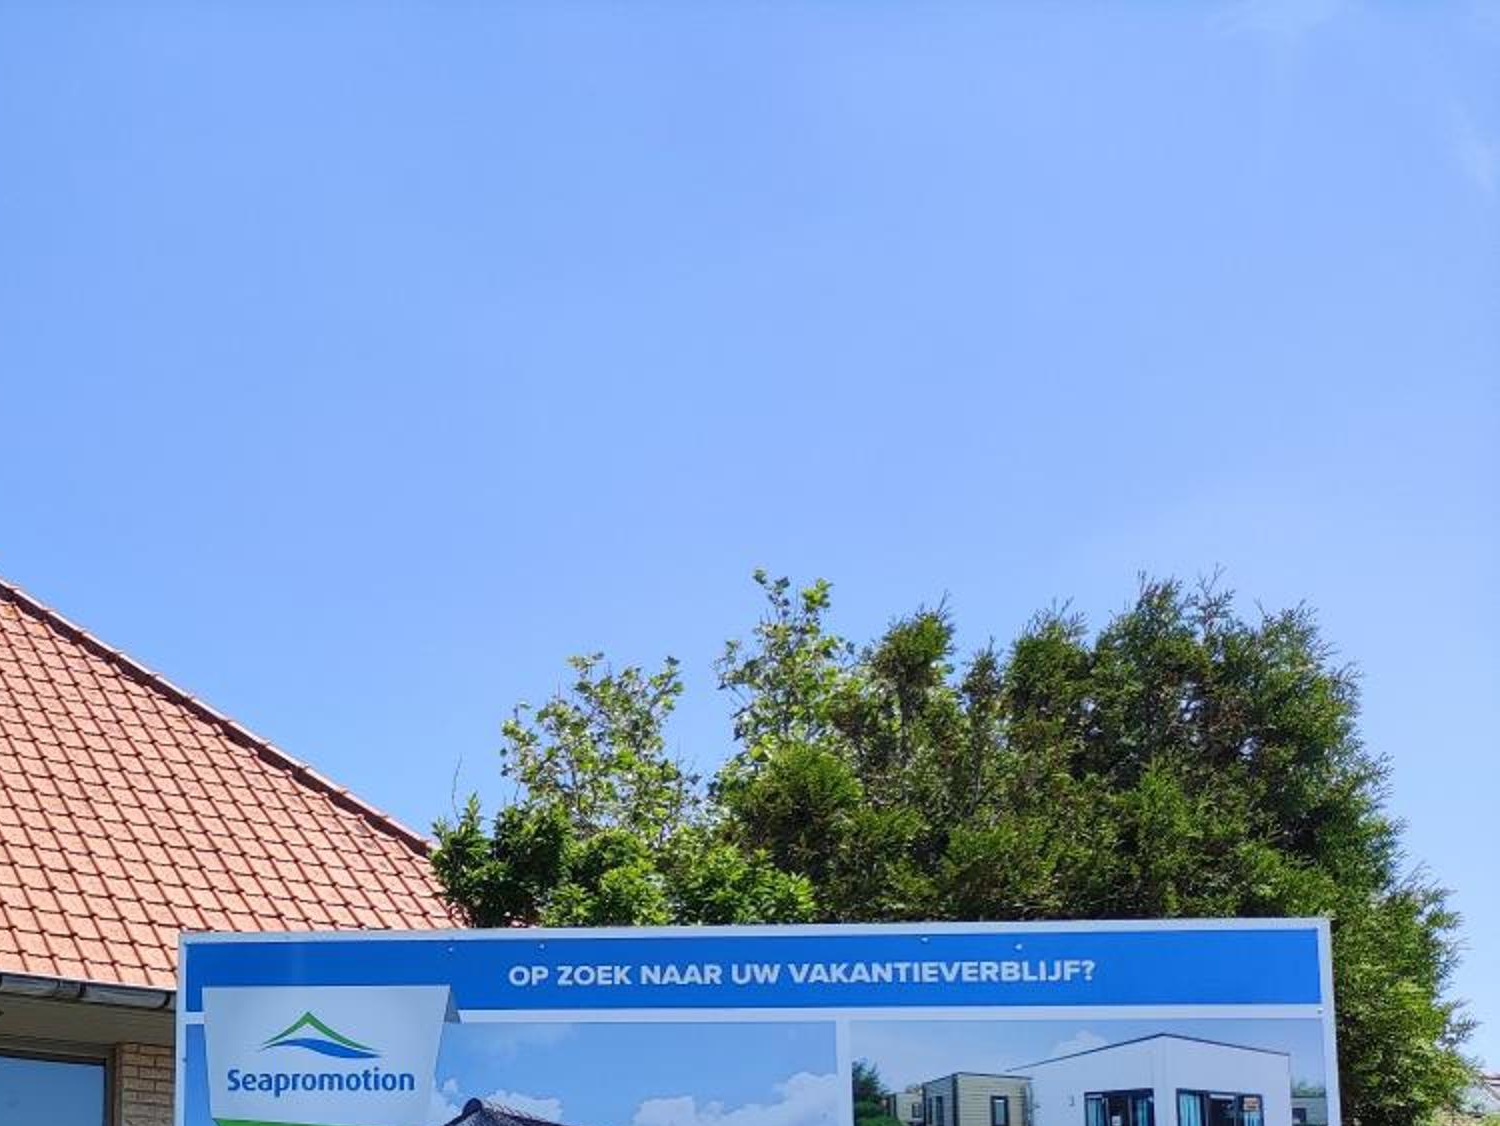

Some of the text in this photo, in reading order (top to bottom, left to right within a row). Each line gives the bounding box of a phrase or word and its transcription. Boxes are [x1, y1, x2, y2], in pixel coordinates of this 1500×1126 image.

[508, 960, 1096, 986] OP ZOEK NAAR UW VAKANTIEVERBLIJF?
[227, 1067, 415, 1097] Seapromotion
